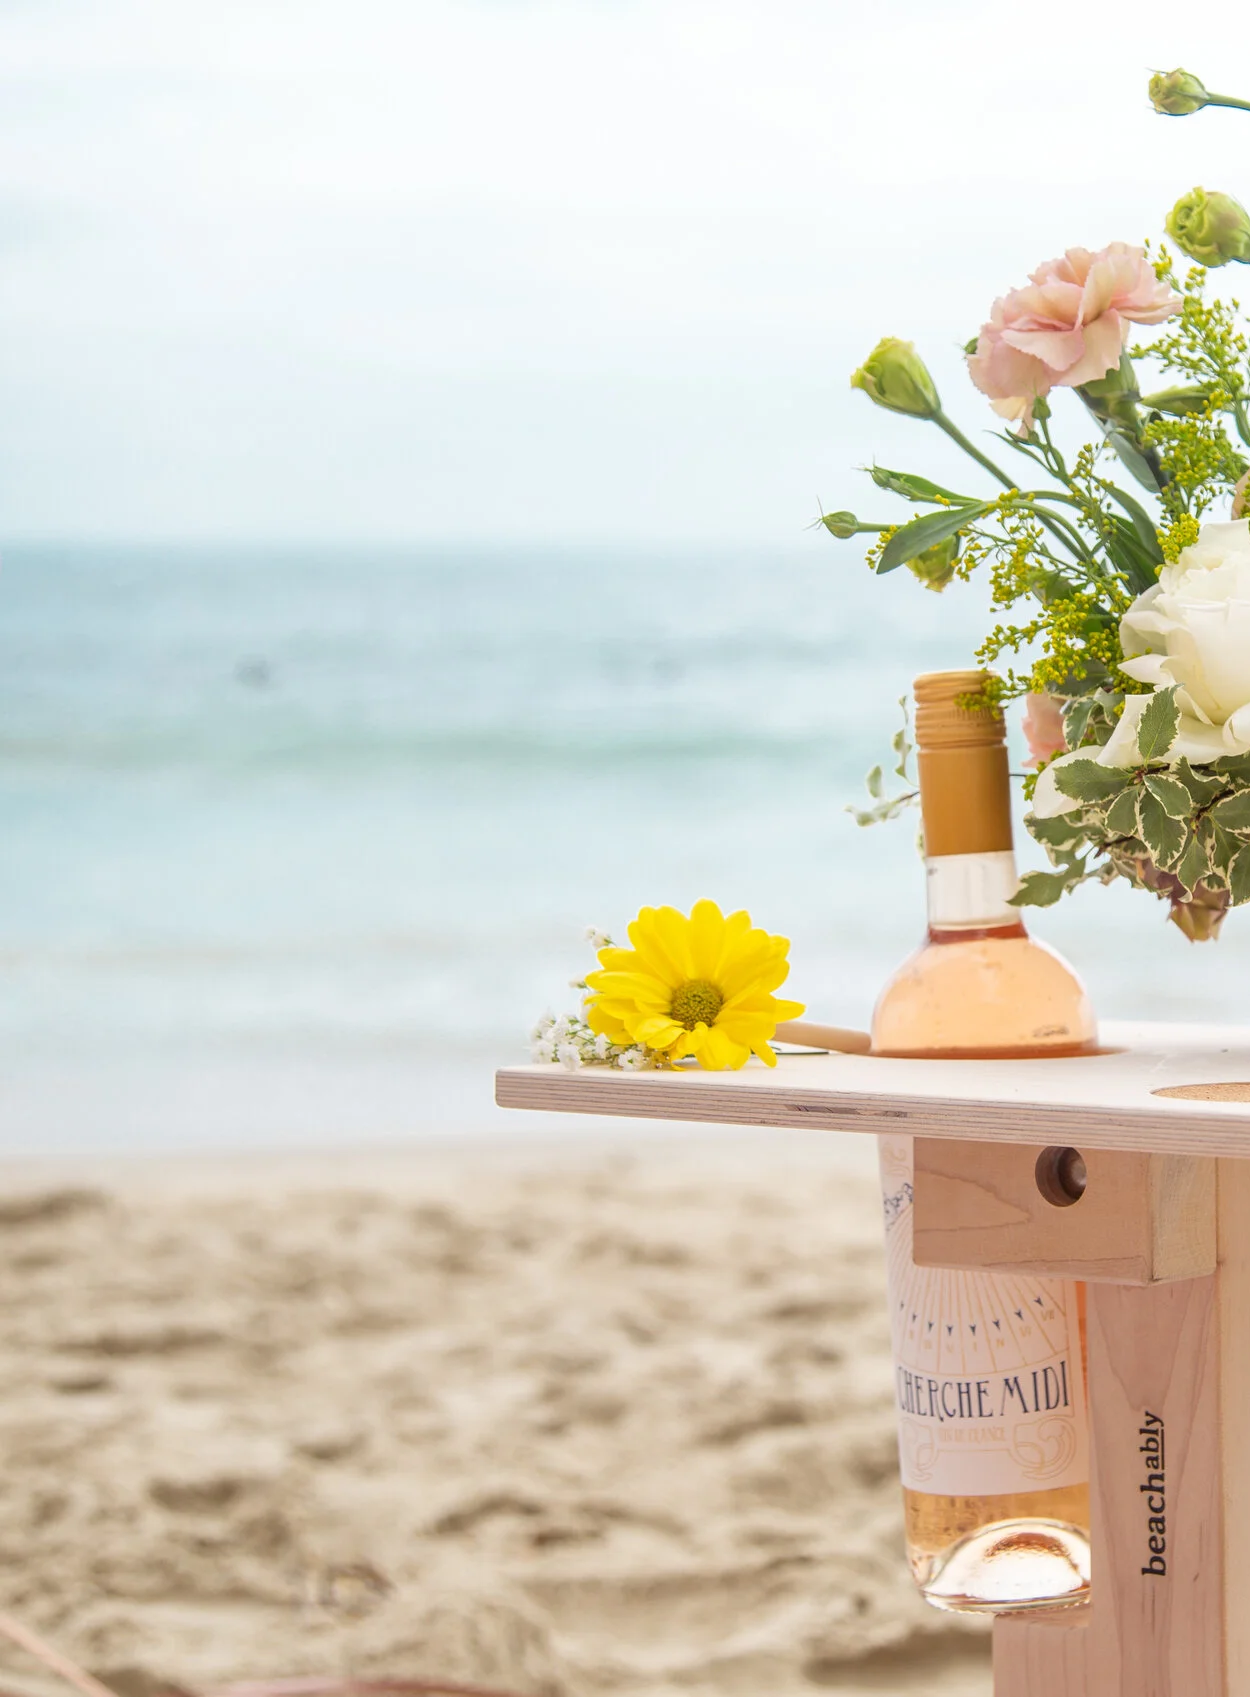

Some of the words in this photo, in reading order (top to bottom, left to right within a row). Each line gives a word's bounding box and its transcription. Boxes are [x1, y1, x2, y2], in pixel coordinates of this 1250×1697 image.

[898, 1366, 993, 1422] CHERCHE
[1000, 1360, 1070, 1416] MIDI
[1139, 1410, 1166, 1576] beachably
